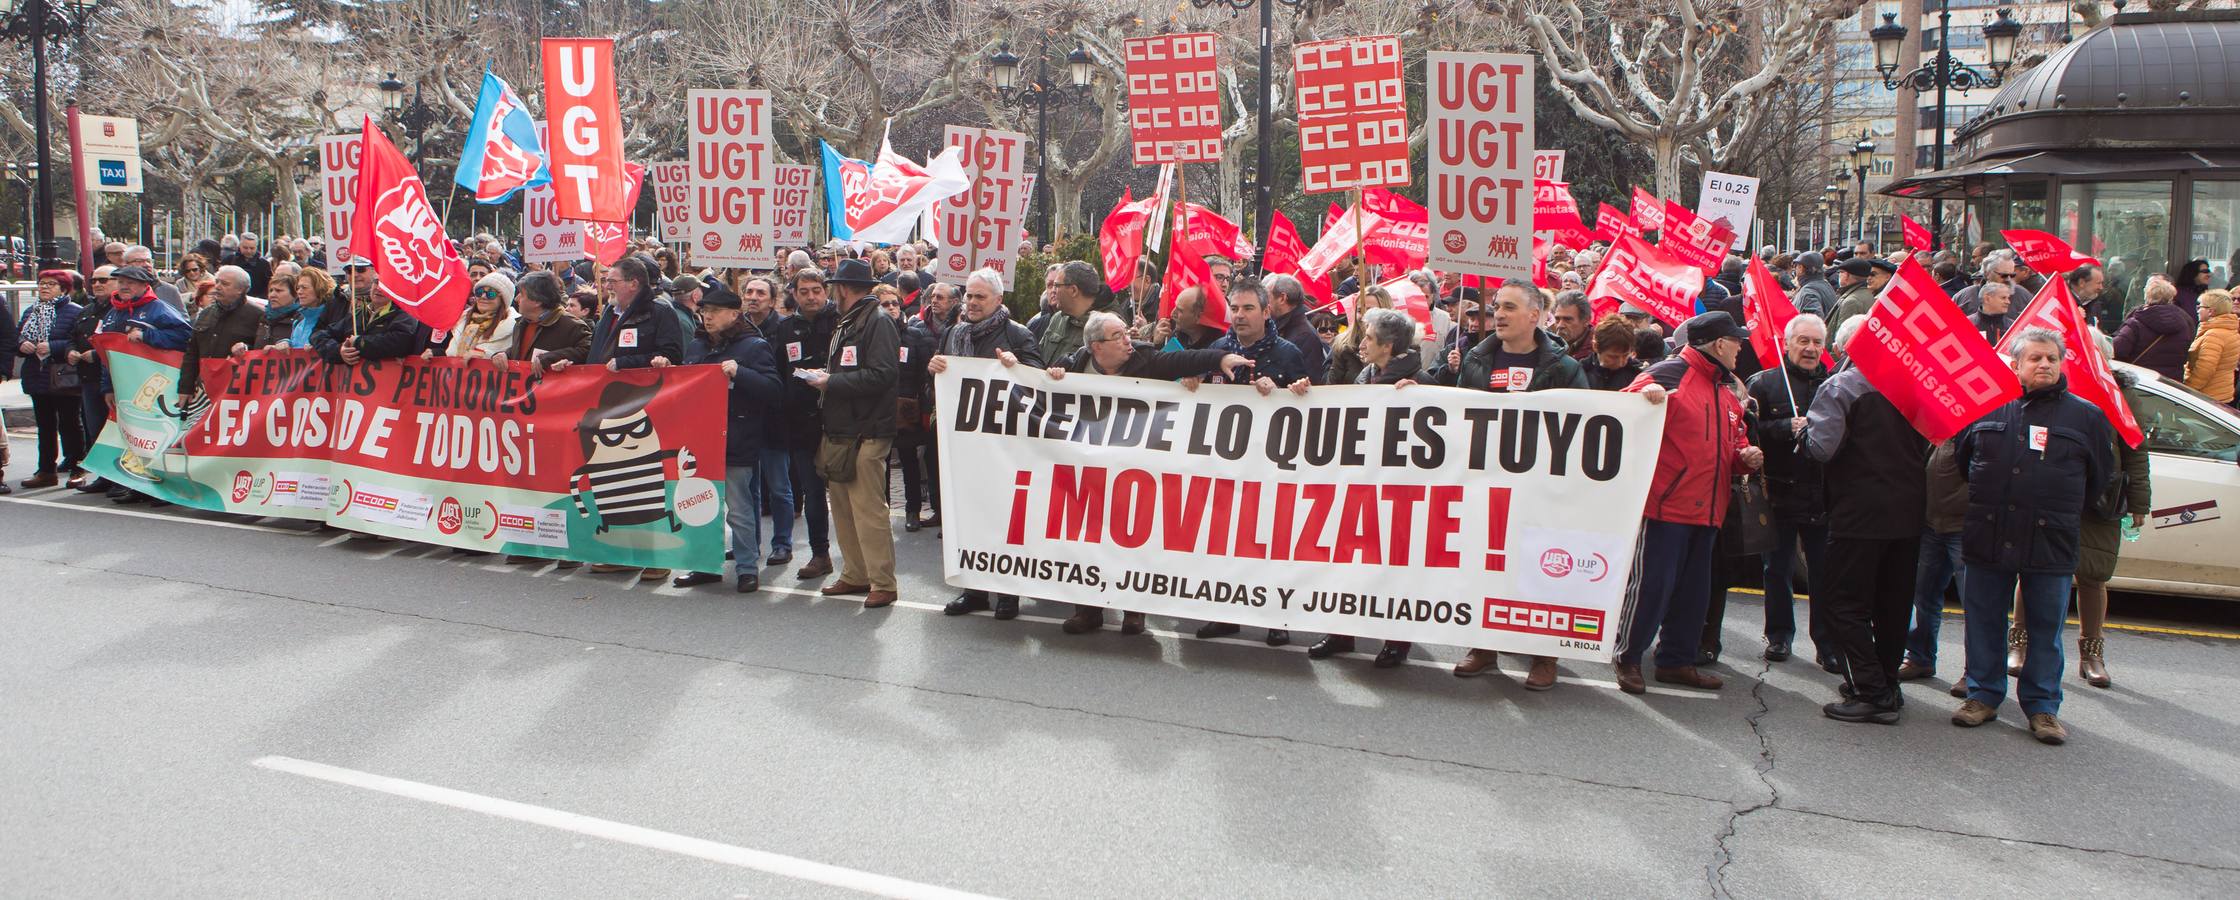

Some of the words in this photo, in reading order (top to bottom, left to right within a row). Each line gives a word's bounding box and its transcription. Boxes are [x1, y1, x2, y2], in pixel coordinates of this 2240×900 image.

[1438, 62, 1524, 113] UGT
[560, 47, 599, 213] UGT
[697, 97, 764, 136] UGT
[326, 140, 362, 172] UG
[1438, 118, 1524, 170] UGT
[101, 168, 125, 178] TAXI
[698, 142, 765, 180] UGT
[1534, 155, 1560, 179] GT
[1438, 174, 1524, 226] UGT
[1710, 180, 1722, 191] El
[1725, 182, 1750, 195] 0,25
[1713, 196, 1723, 204] es
[1725, 198, 1741, 206] una
[530, 197, 574, 228] UG
[663, 205, 691, 224] UG
[699, 186, 766, 225] UGT
[1533, 204, 1575, 214] onistas
[946, 212, 1011, 251] UGT
[1867, 315, 1967, 418] ensionistas
[392, 365, 544, 416] PENSIONES
[266, 397, 338, 450] COS
[955, 377, 1180, 452] DEFIENDE
[1187, 403, 1254, 461] LO
[1265, 406, 1370, 471] QUE
[1381, 406, 1448, 470] ES
[1464, 408, 1624, 482] TUYO
[355, 493, 386, 506] CCOO
[464, 507, 481, 518] UJP
[677, 489, 714, 511] PENSIONES
[501, 516, 524, 526] CCOO
[1046, 464, 1464, 569] MOVILIZATE
[1577, 559, 1597, 568] UJP
[958, 548, 1107, 592] NSIONISTAS,
[1115, 570, 1267, 607] JUBILADAS
[1277, 587, 1295, 610] Y
[1302, 591, 1472, 626] JUBILIADOS
[1488, 604, 1570, 631] CCOO
[1560, 639, 1571, 648] LA
[1574, 641, 1601, 651] RIOJA
